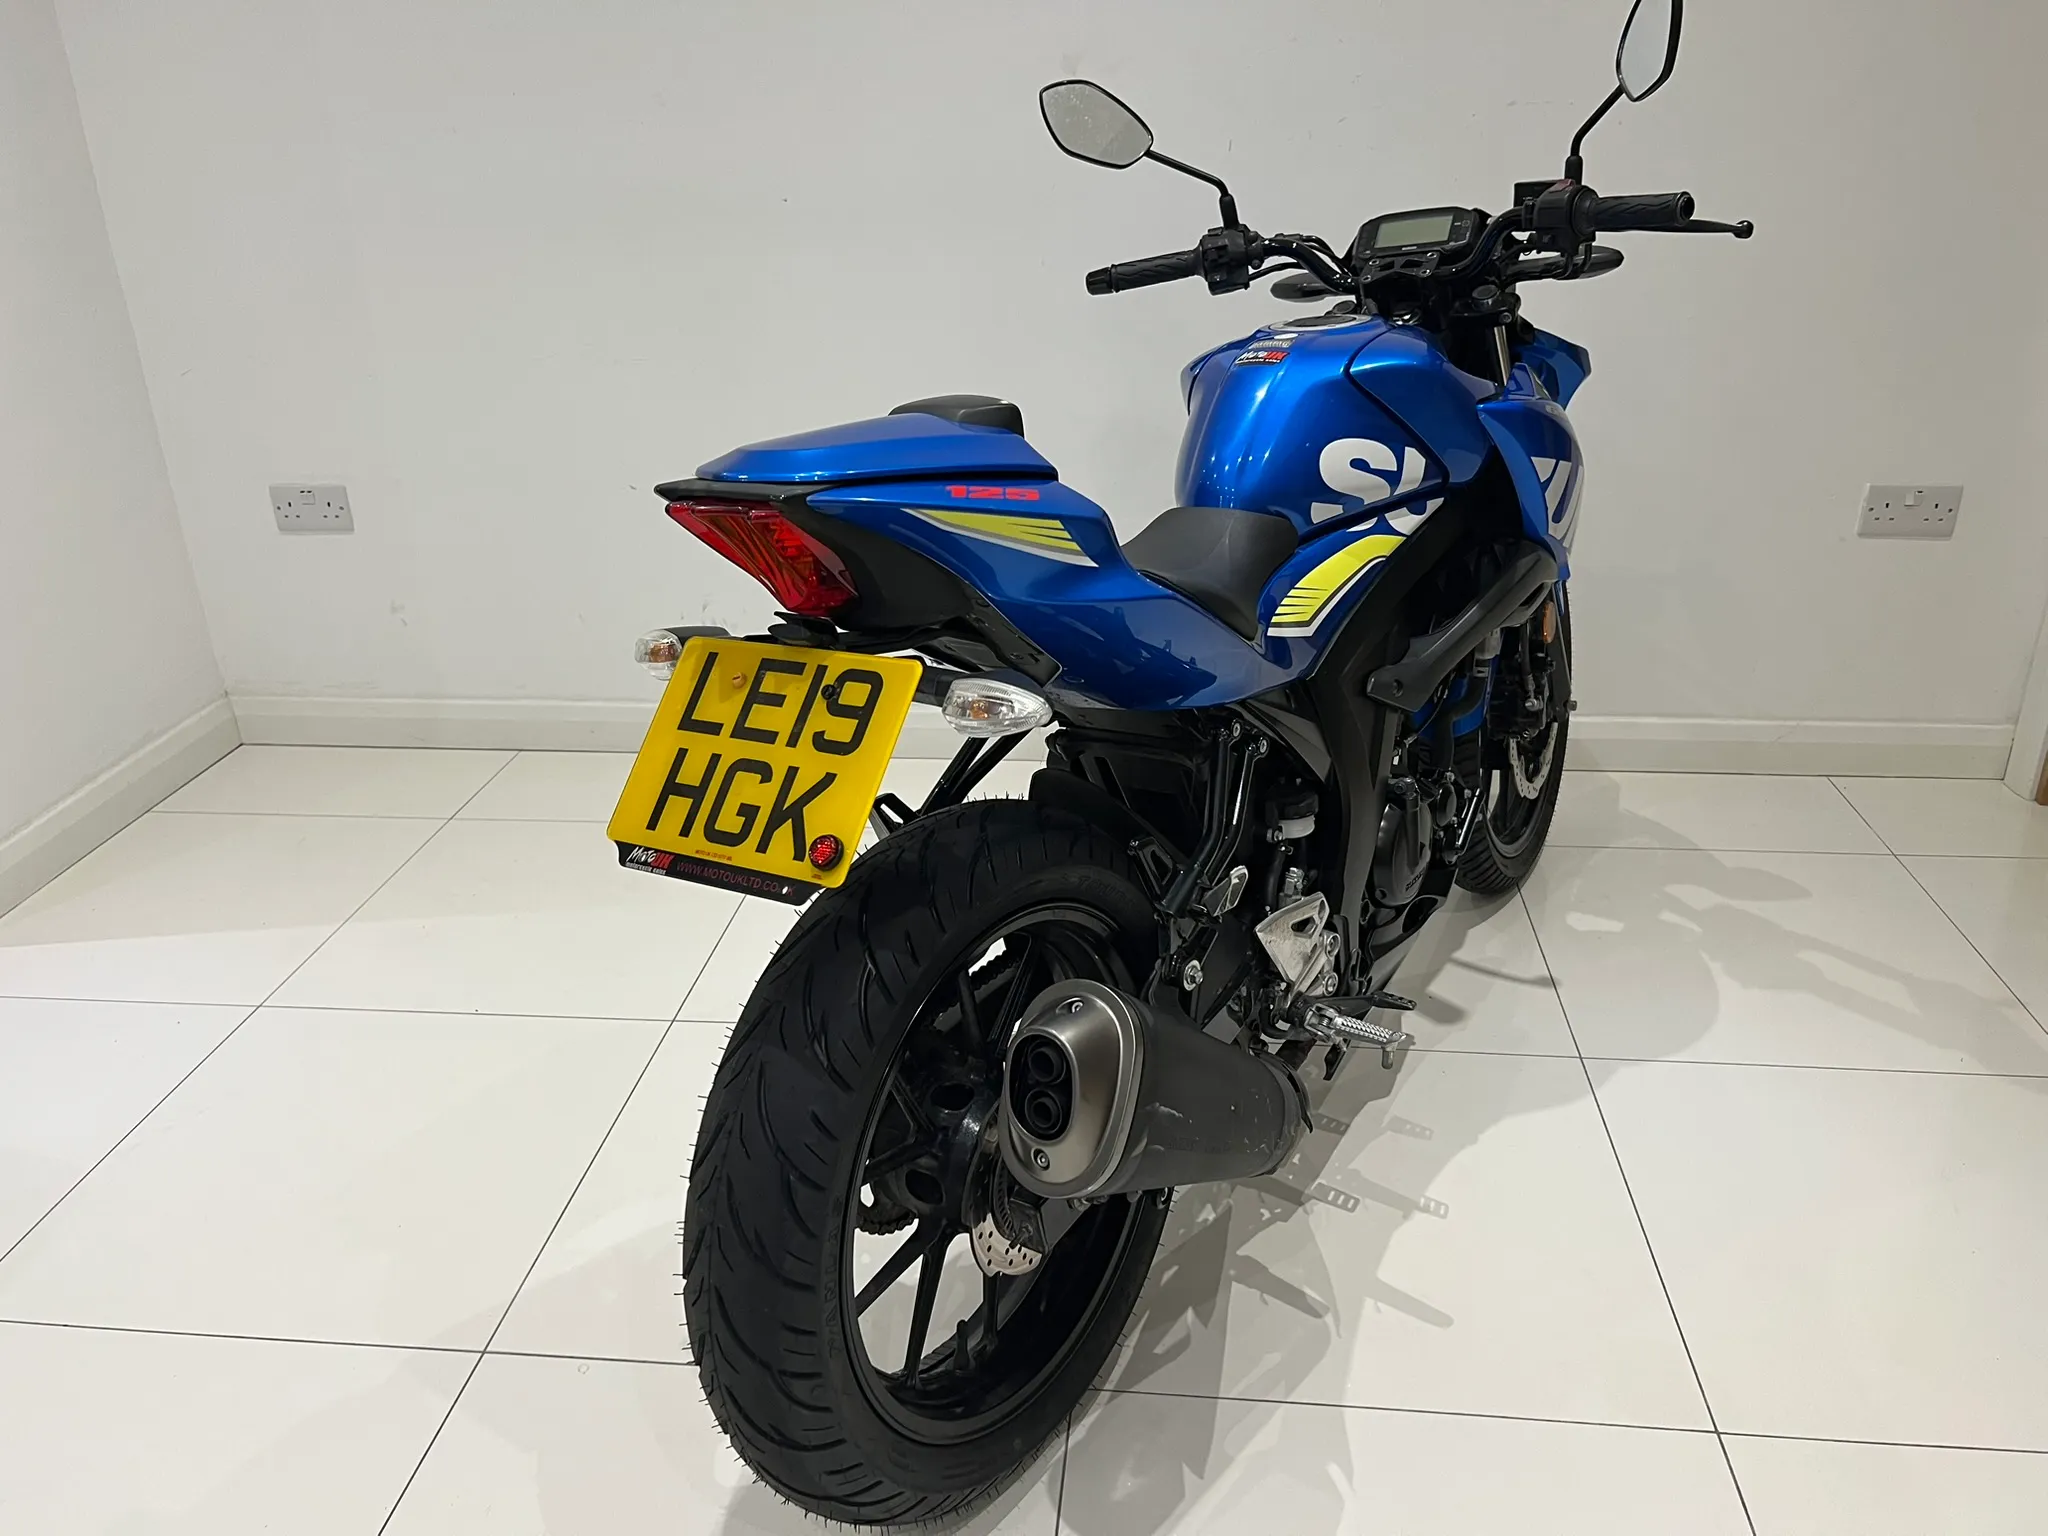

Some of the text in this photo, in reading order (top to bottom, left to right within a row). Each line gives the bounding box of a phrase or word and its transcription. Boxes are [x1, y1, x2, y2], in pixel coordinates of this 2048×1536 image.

[945, 484, 1040, 501] 125
[676, 651, 885, 757] LE19
[645, 746, 838, 863] HGK
[676, 861, 797, 897] WWW.MOTOUKLTD.CO.K
